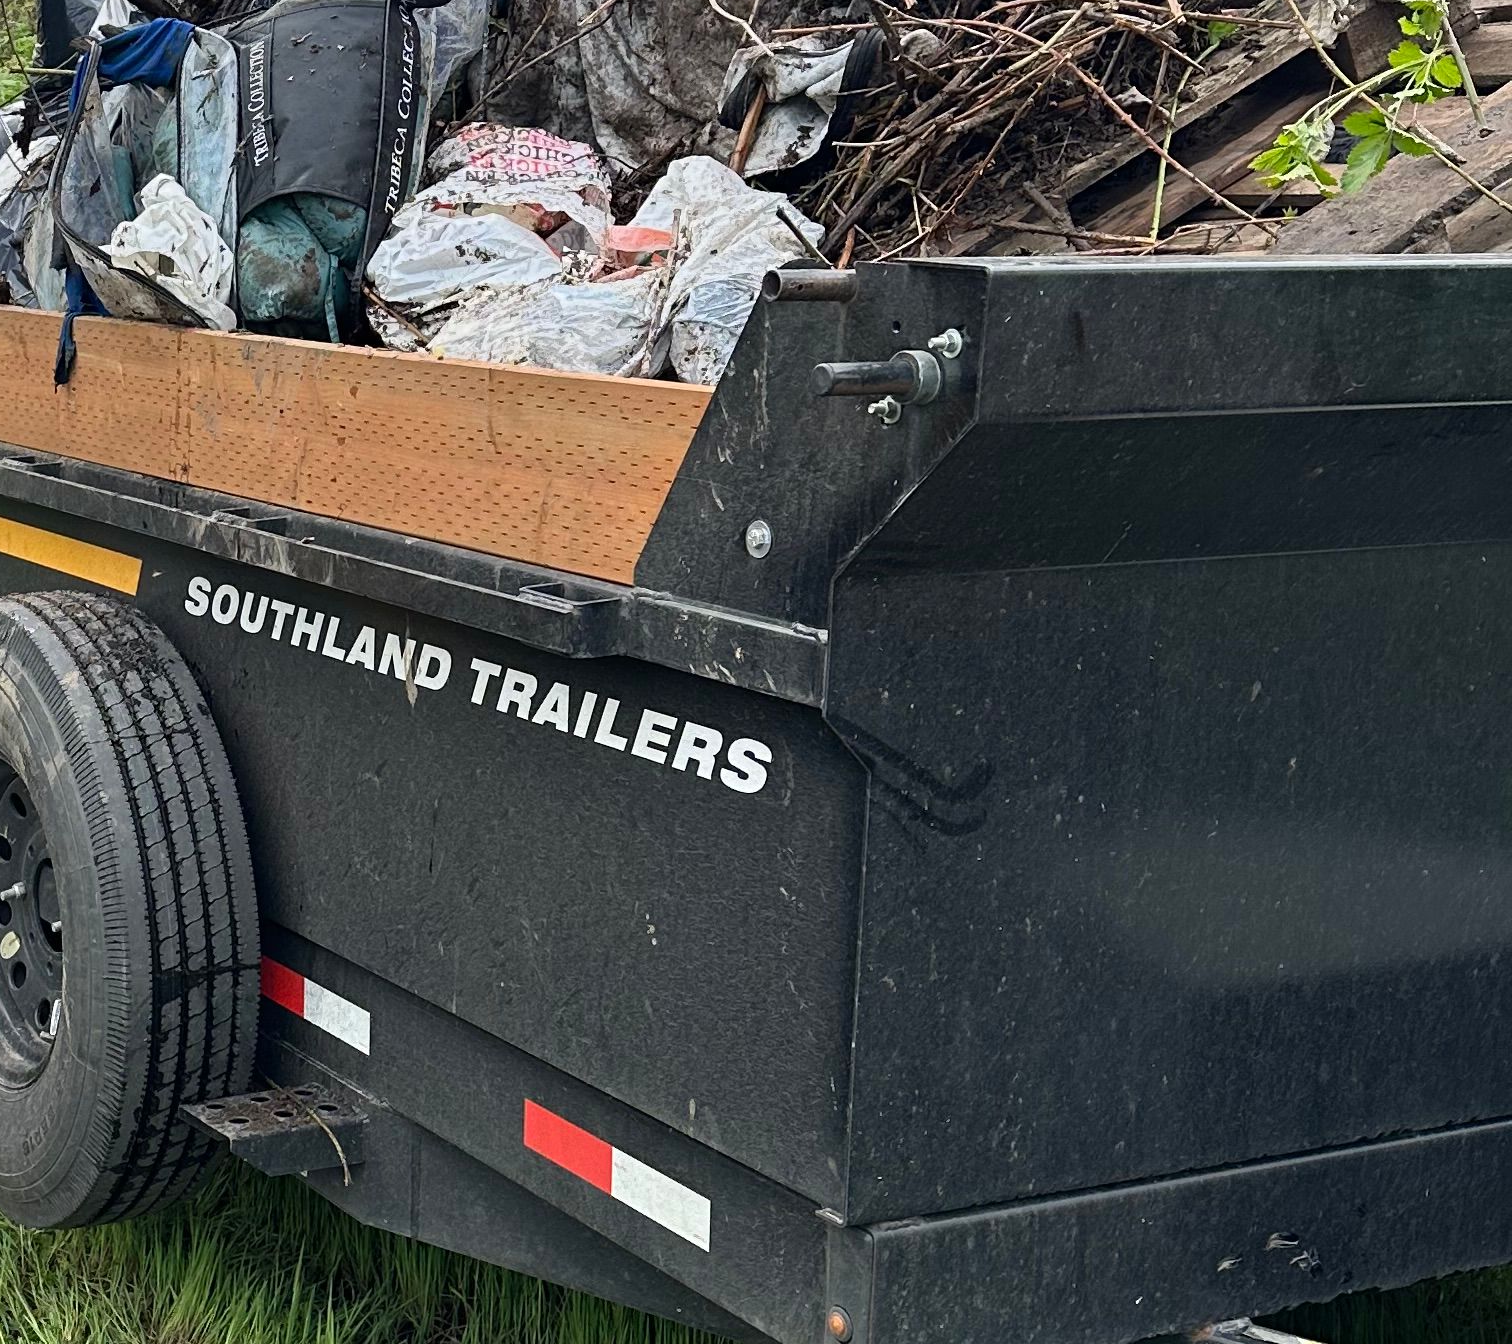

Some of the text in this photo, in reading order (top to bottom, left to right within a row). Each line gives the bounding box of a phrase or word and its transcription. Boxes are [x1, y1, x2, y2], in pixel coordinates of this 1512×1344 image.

[247, 40, 266, 113] COLLECTION
[384, 127, 408, 214] TRIBECA
[184, 576, 773, 794] SOUTHLAND TRAILERS
